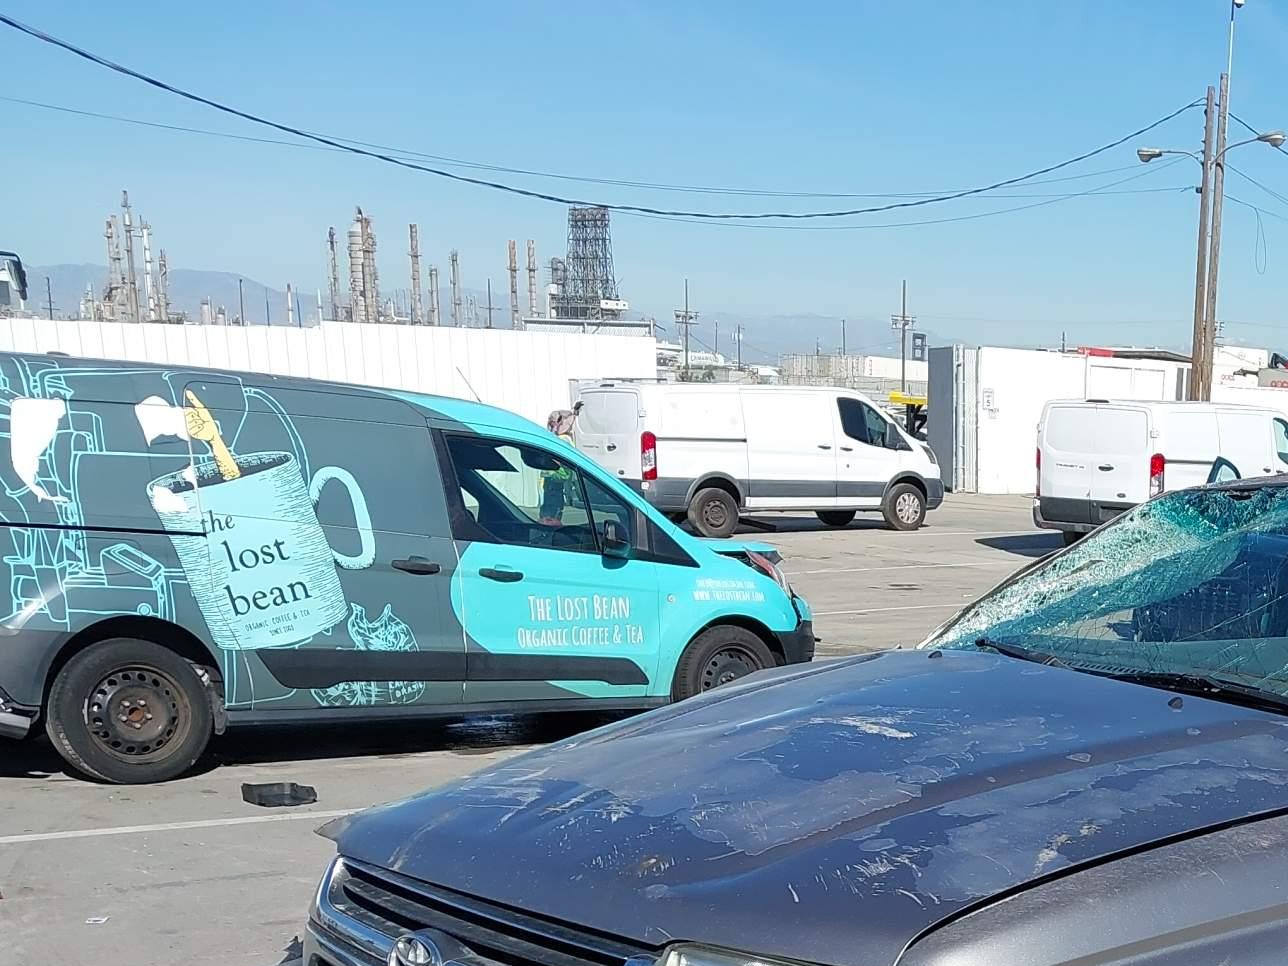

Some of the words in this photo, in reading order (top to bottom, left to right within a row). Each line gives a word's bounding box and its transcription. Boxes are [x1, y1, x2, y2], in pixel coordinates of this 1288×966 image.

[200, 510, 235, 534] the
[221, 539, 290, 572] lost
[223, 580, 312, 616] bean
[613, 627, 621, 643] &
